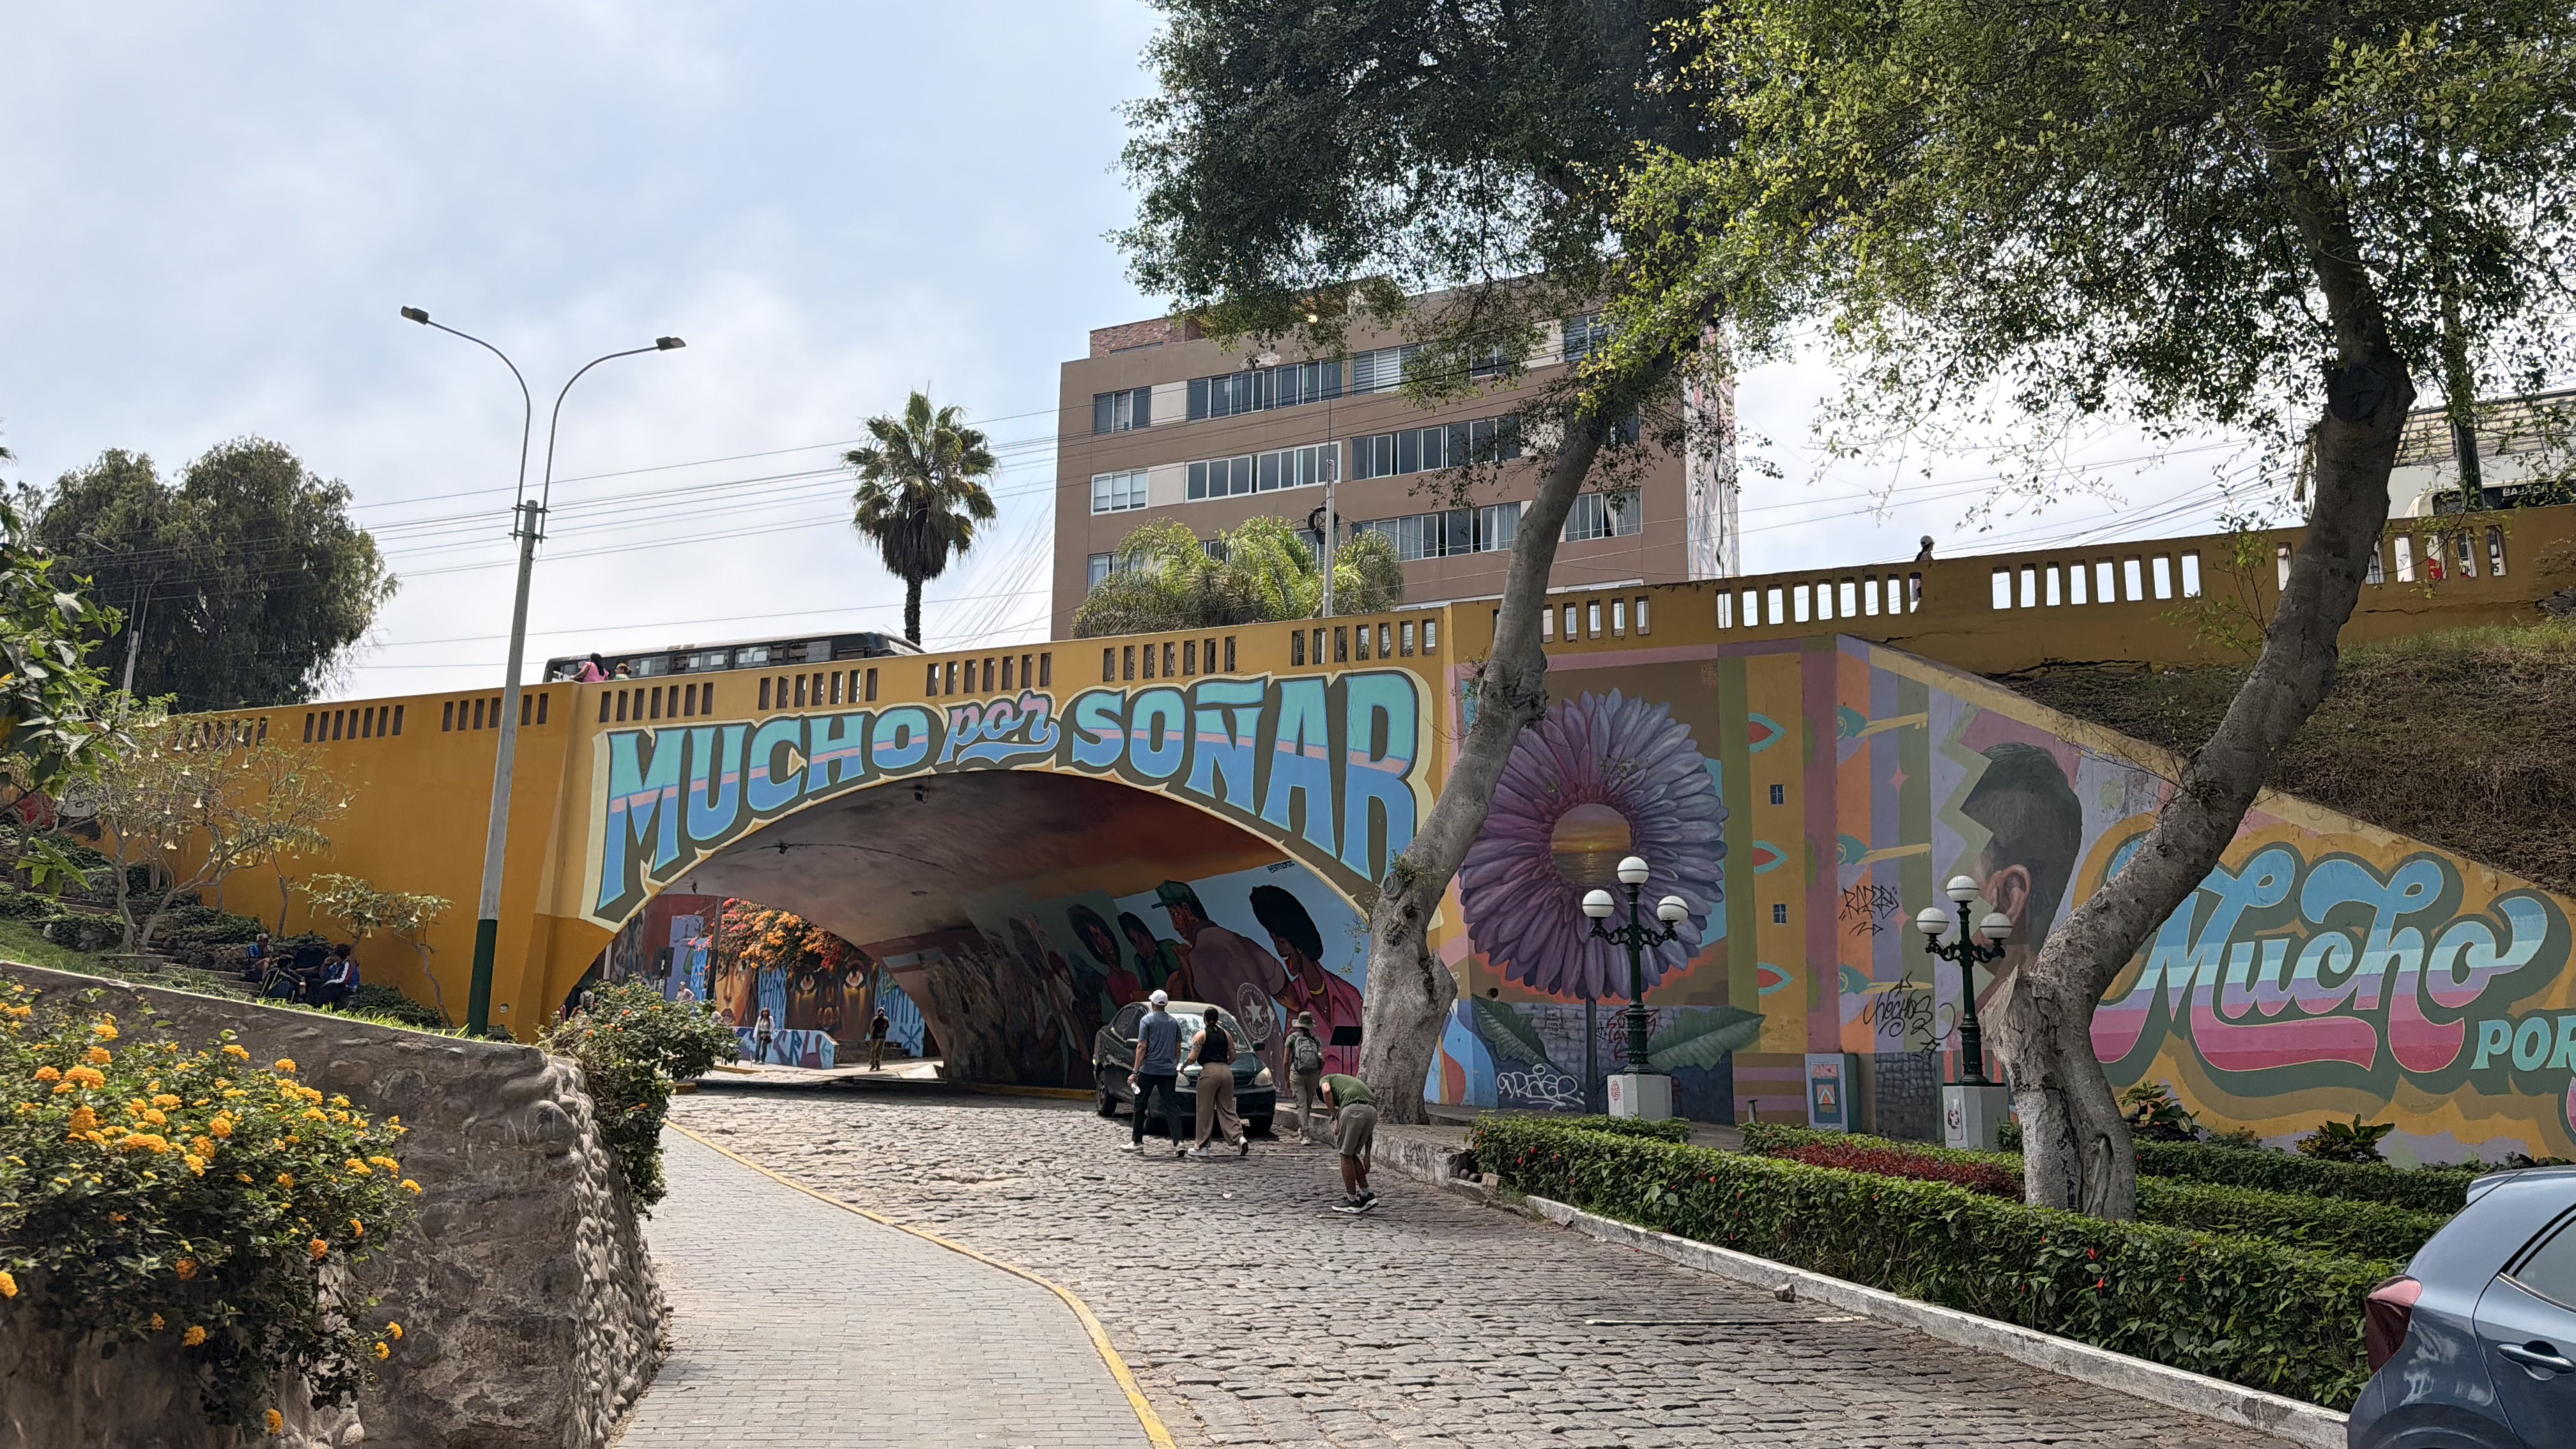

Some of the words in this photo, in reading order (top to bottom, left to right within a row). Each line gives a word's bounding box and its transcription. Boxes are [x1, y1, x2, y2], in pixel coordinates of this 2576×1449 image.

[597, 707, 931, 911] MUCHO
[937, 691, 1061, 765] por
[1072, 672, 1416, 883] SOÑAR
[2089, 838, 2549, 1073] Mucho
